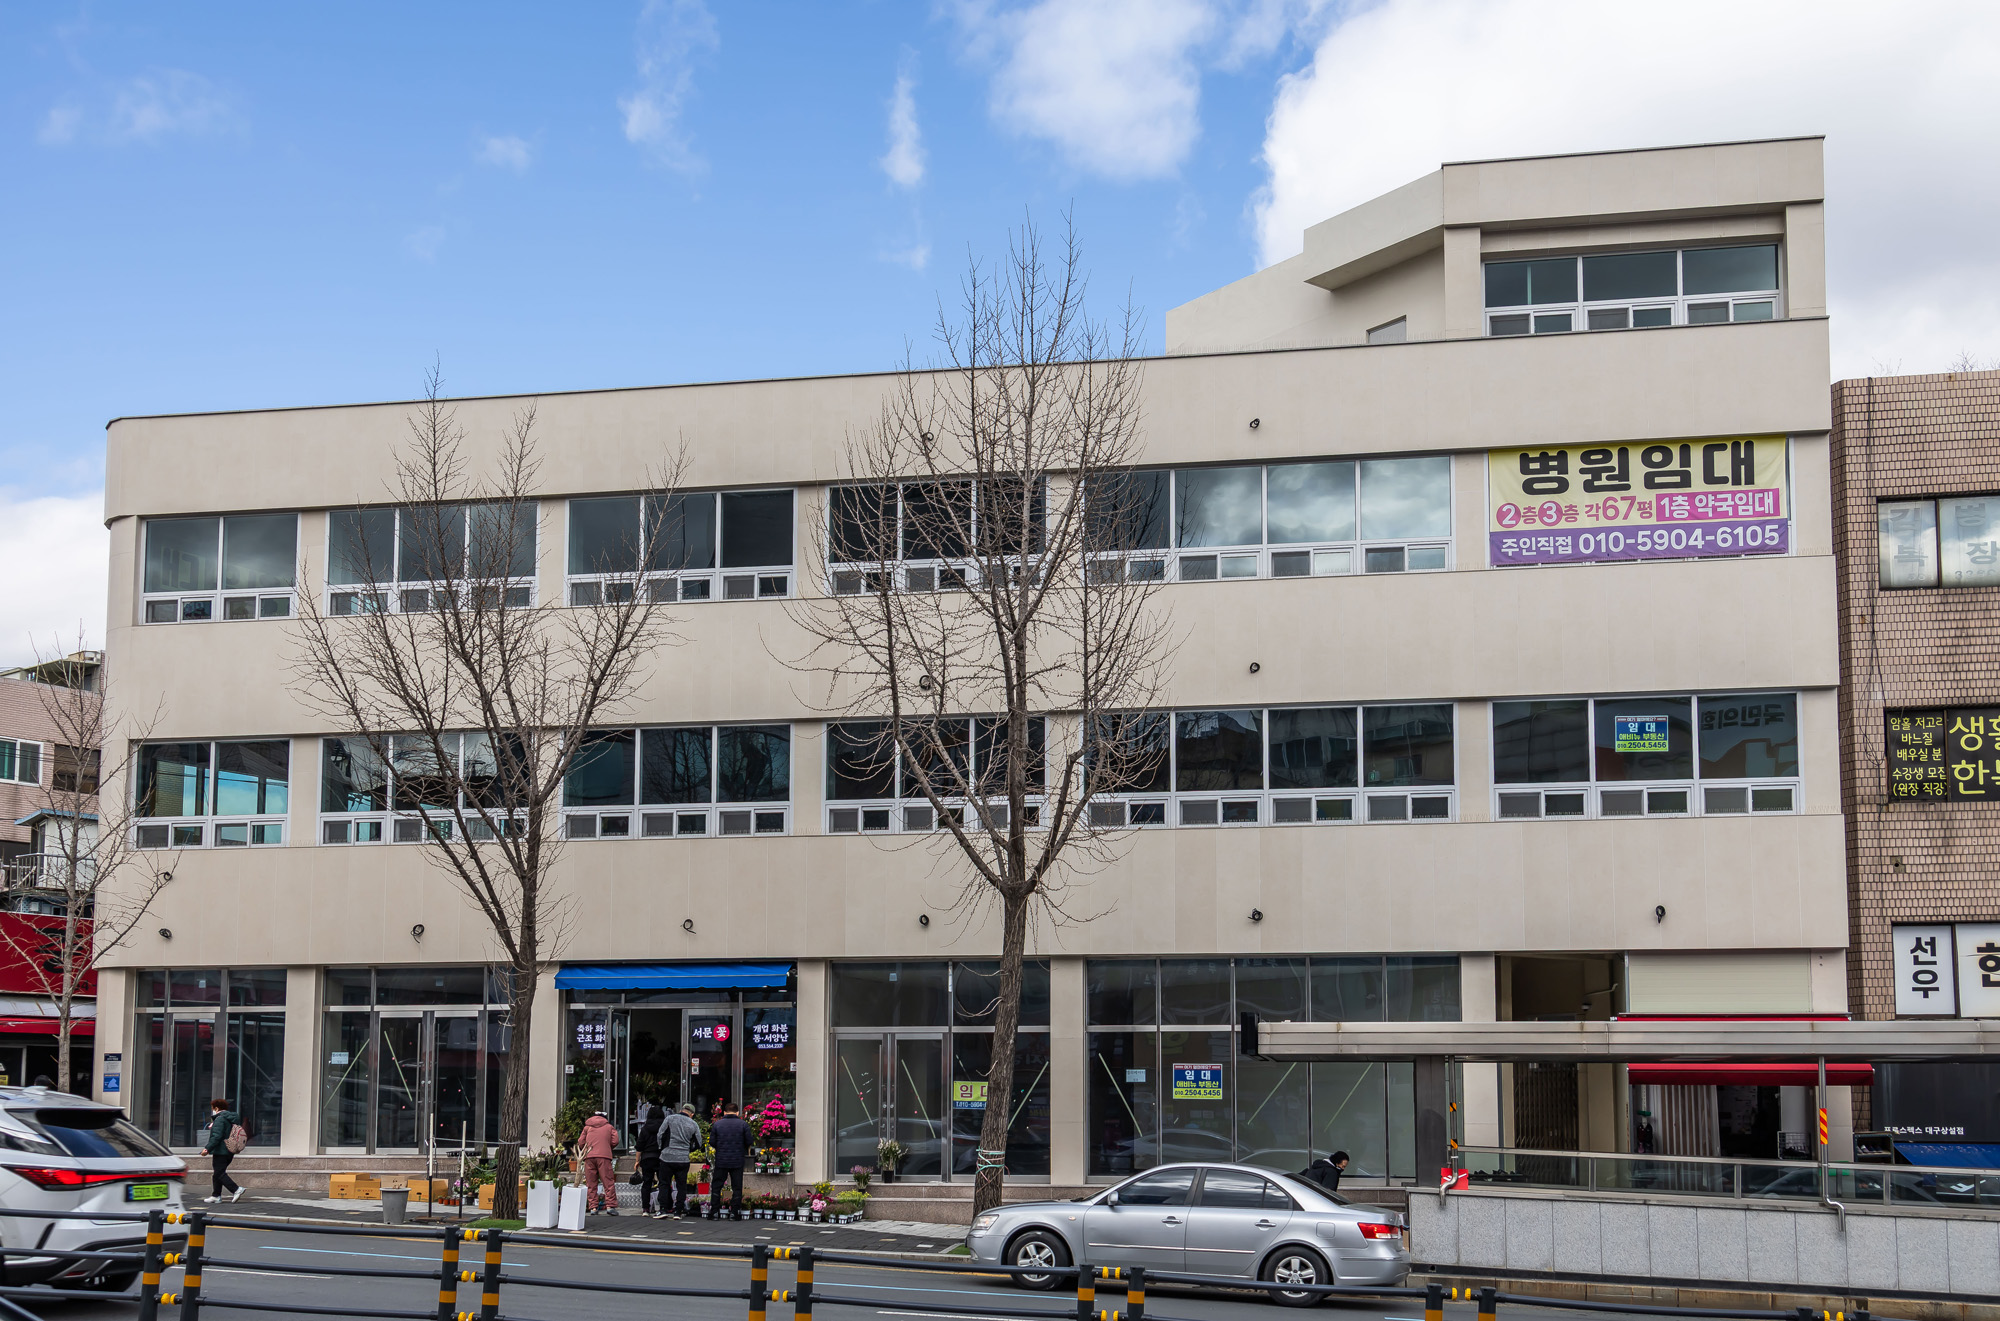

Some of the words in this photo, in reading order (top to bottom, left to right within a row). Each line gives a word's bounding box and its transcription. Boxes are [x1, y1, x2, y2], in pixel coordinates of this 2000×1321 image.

[1519, 440, 1755, 495] 병원임대
[1660, 494, 1691, 519] 1층
[1695, 491, 1774, 517] 약국임대
[1501, 535, 1573, 556] 주인직접
[1579, 524, 1780, 554] 010-5904-6105
[1890, 717, 1911, 731] 암홀
[1643, 732, 1665, 740] 부동산
[1901, 732, 1933, 746] 바느질
[1896, 748, 1928, 762] 배우실
[1932, 748, 1943, 761] 분
[1892, 767, 1924, 780] 수강생
[1892, 782, 1919, 796] (원장
[1910, 936, 1940, 999] 선우
[576, 1024, 594, 1033] 축하
[595, 1024, 606, 1033] 화
[692, 1026, 713, 1039] 서문
[716, 1026, 727, 1039] 꽃
[753, 1024, 769, 1033] 개업
[771, 1024, 788, 1033] 화분
[576, 1034, 593, 1042] 근조
[595, 1034, 606, 1042] 화
[1198, 1080, 1219, 1088] 부동산
[1925, 1126, 1965, 1135] 대구상설점
